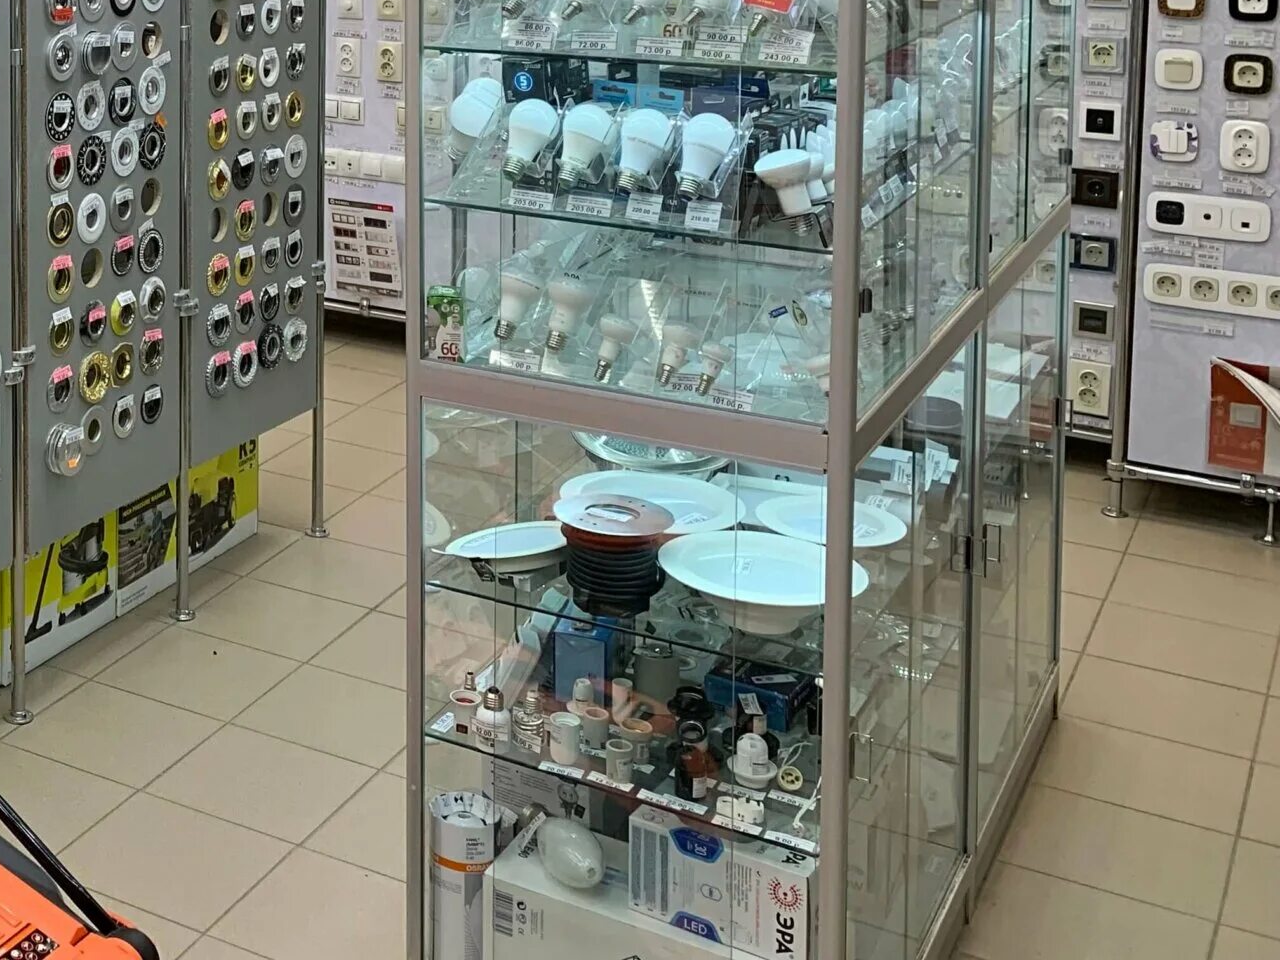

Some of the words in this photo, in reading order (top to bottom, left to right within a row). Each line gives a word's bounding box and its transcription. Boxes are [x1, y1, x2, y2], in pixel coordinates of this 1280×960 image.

[513, 198, 537, 207] 203.00
[781, 850, 808, 868] РА
[684, 918, 708, 936] LED
[775, 912, 795, 954] ЭРА
